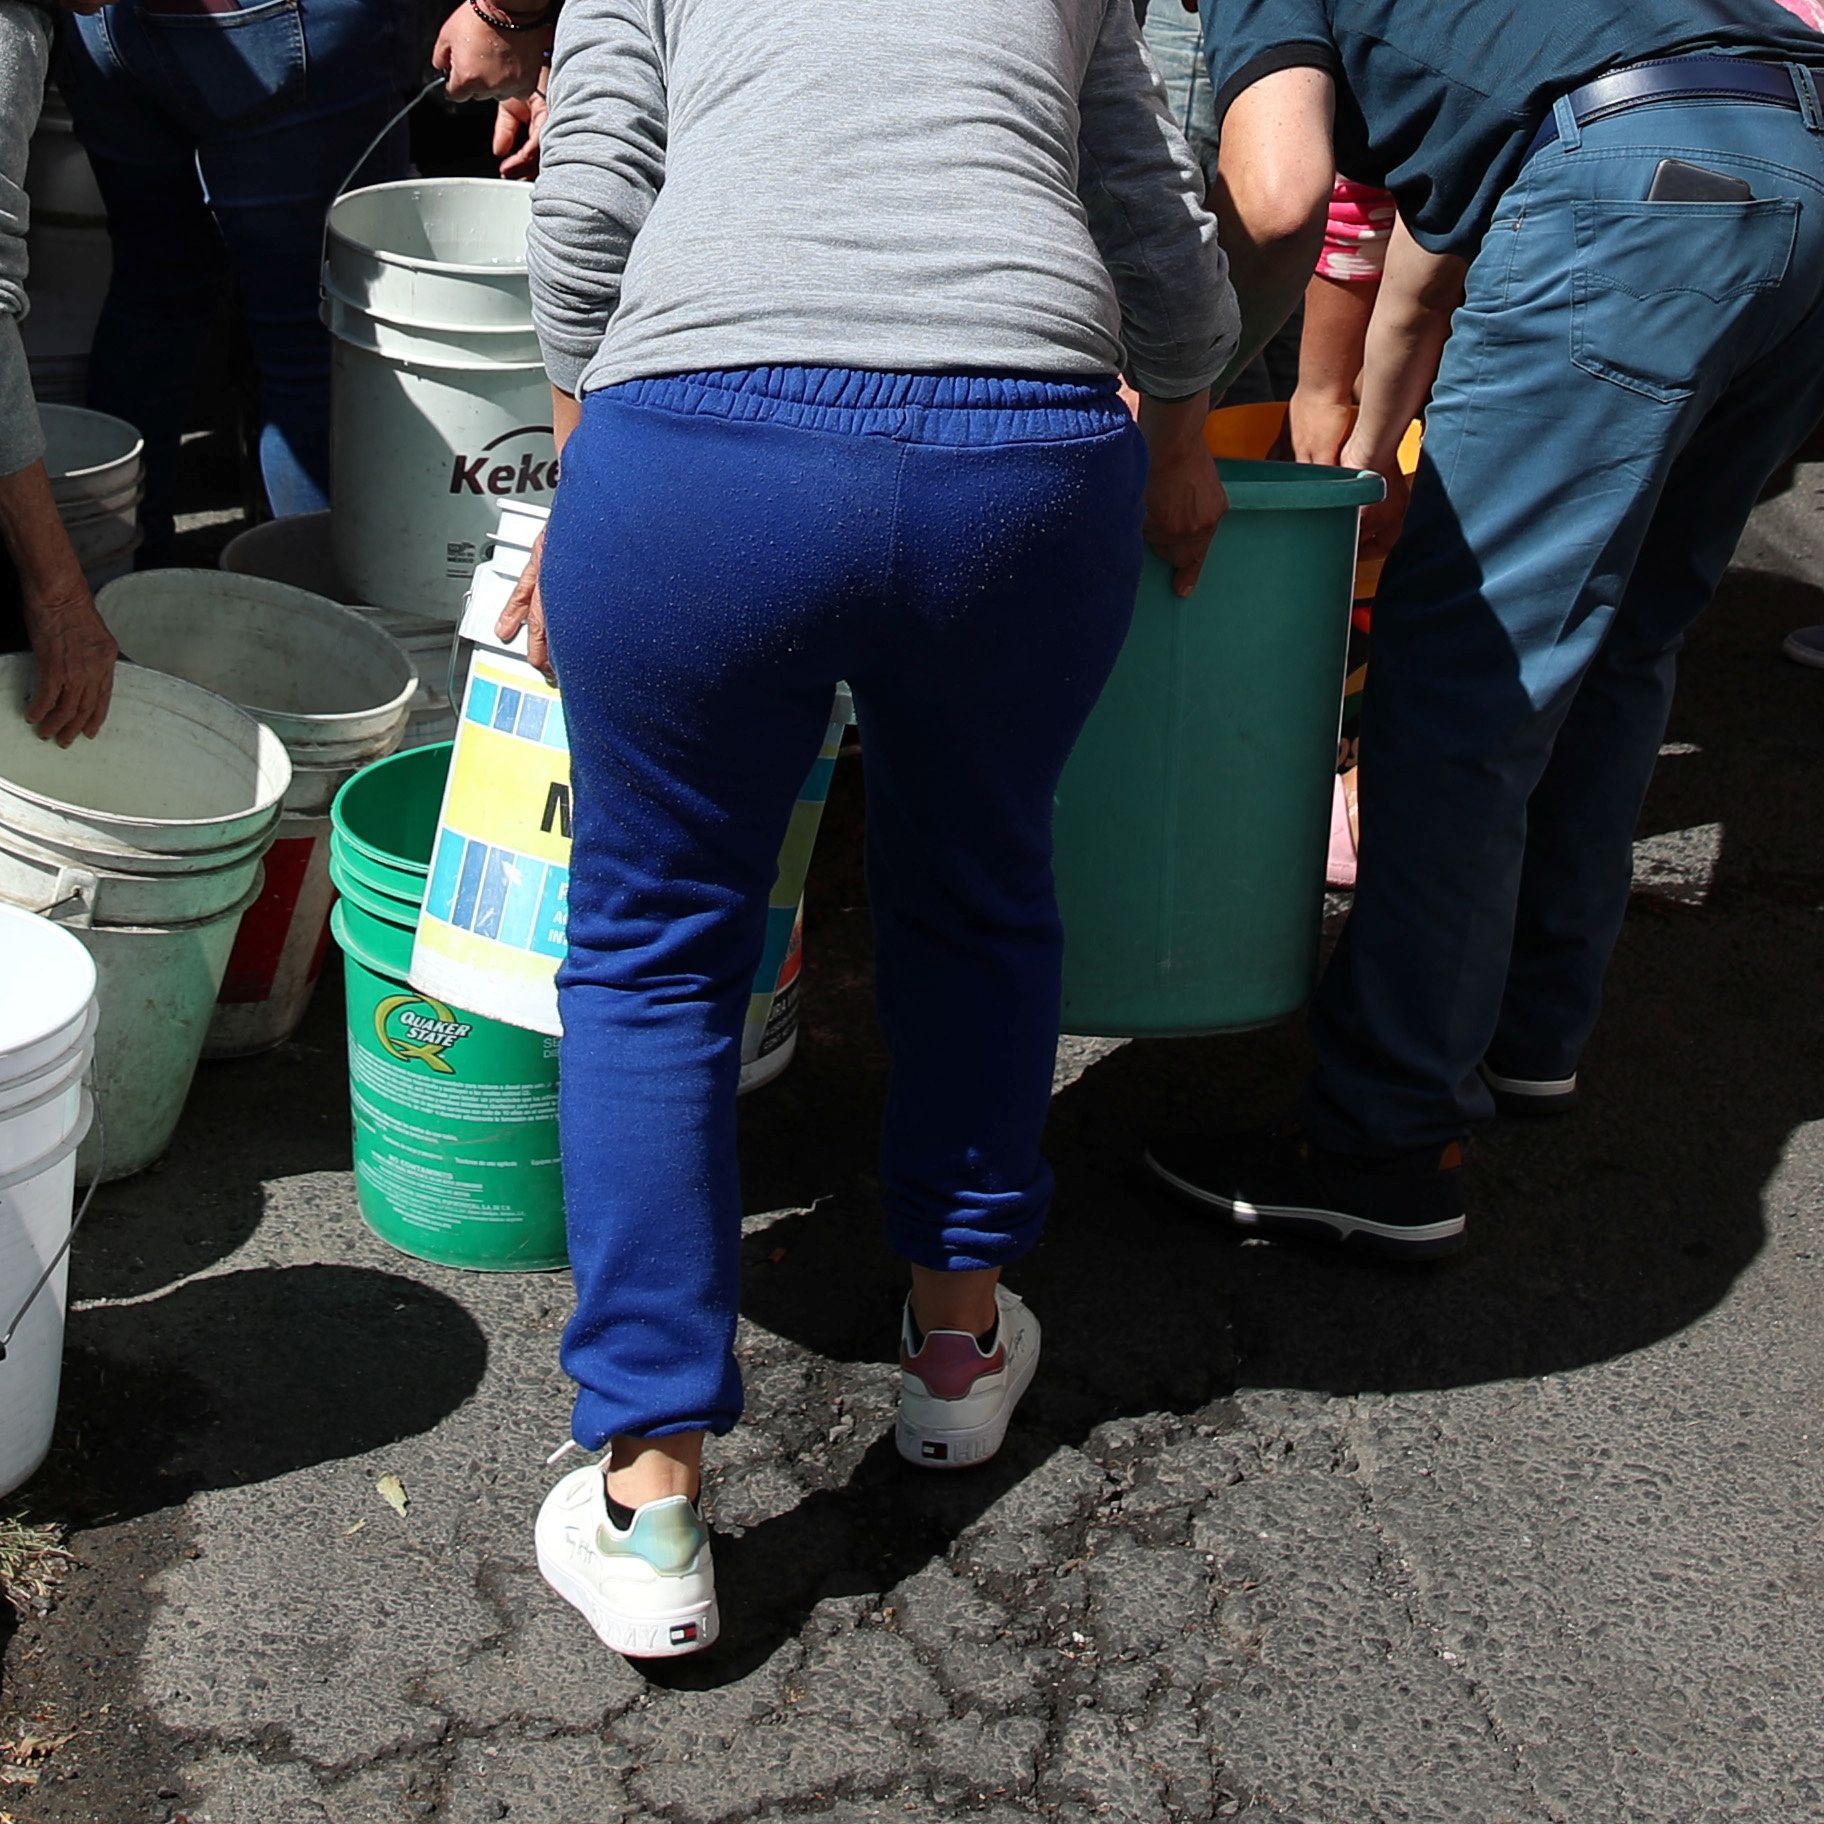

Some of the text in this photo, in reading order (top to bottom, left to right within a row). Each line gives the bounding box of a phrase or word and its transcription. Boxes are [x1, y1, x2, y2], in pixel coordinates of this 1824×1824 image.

[448, 452, 561, 496] Keke
[399, 1011, 471, 1038] QUAKER
[406, 1027, 458, 1048] STATE
